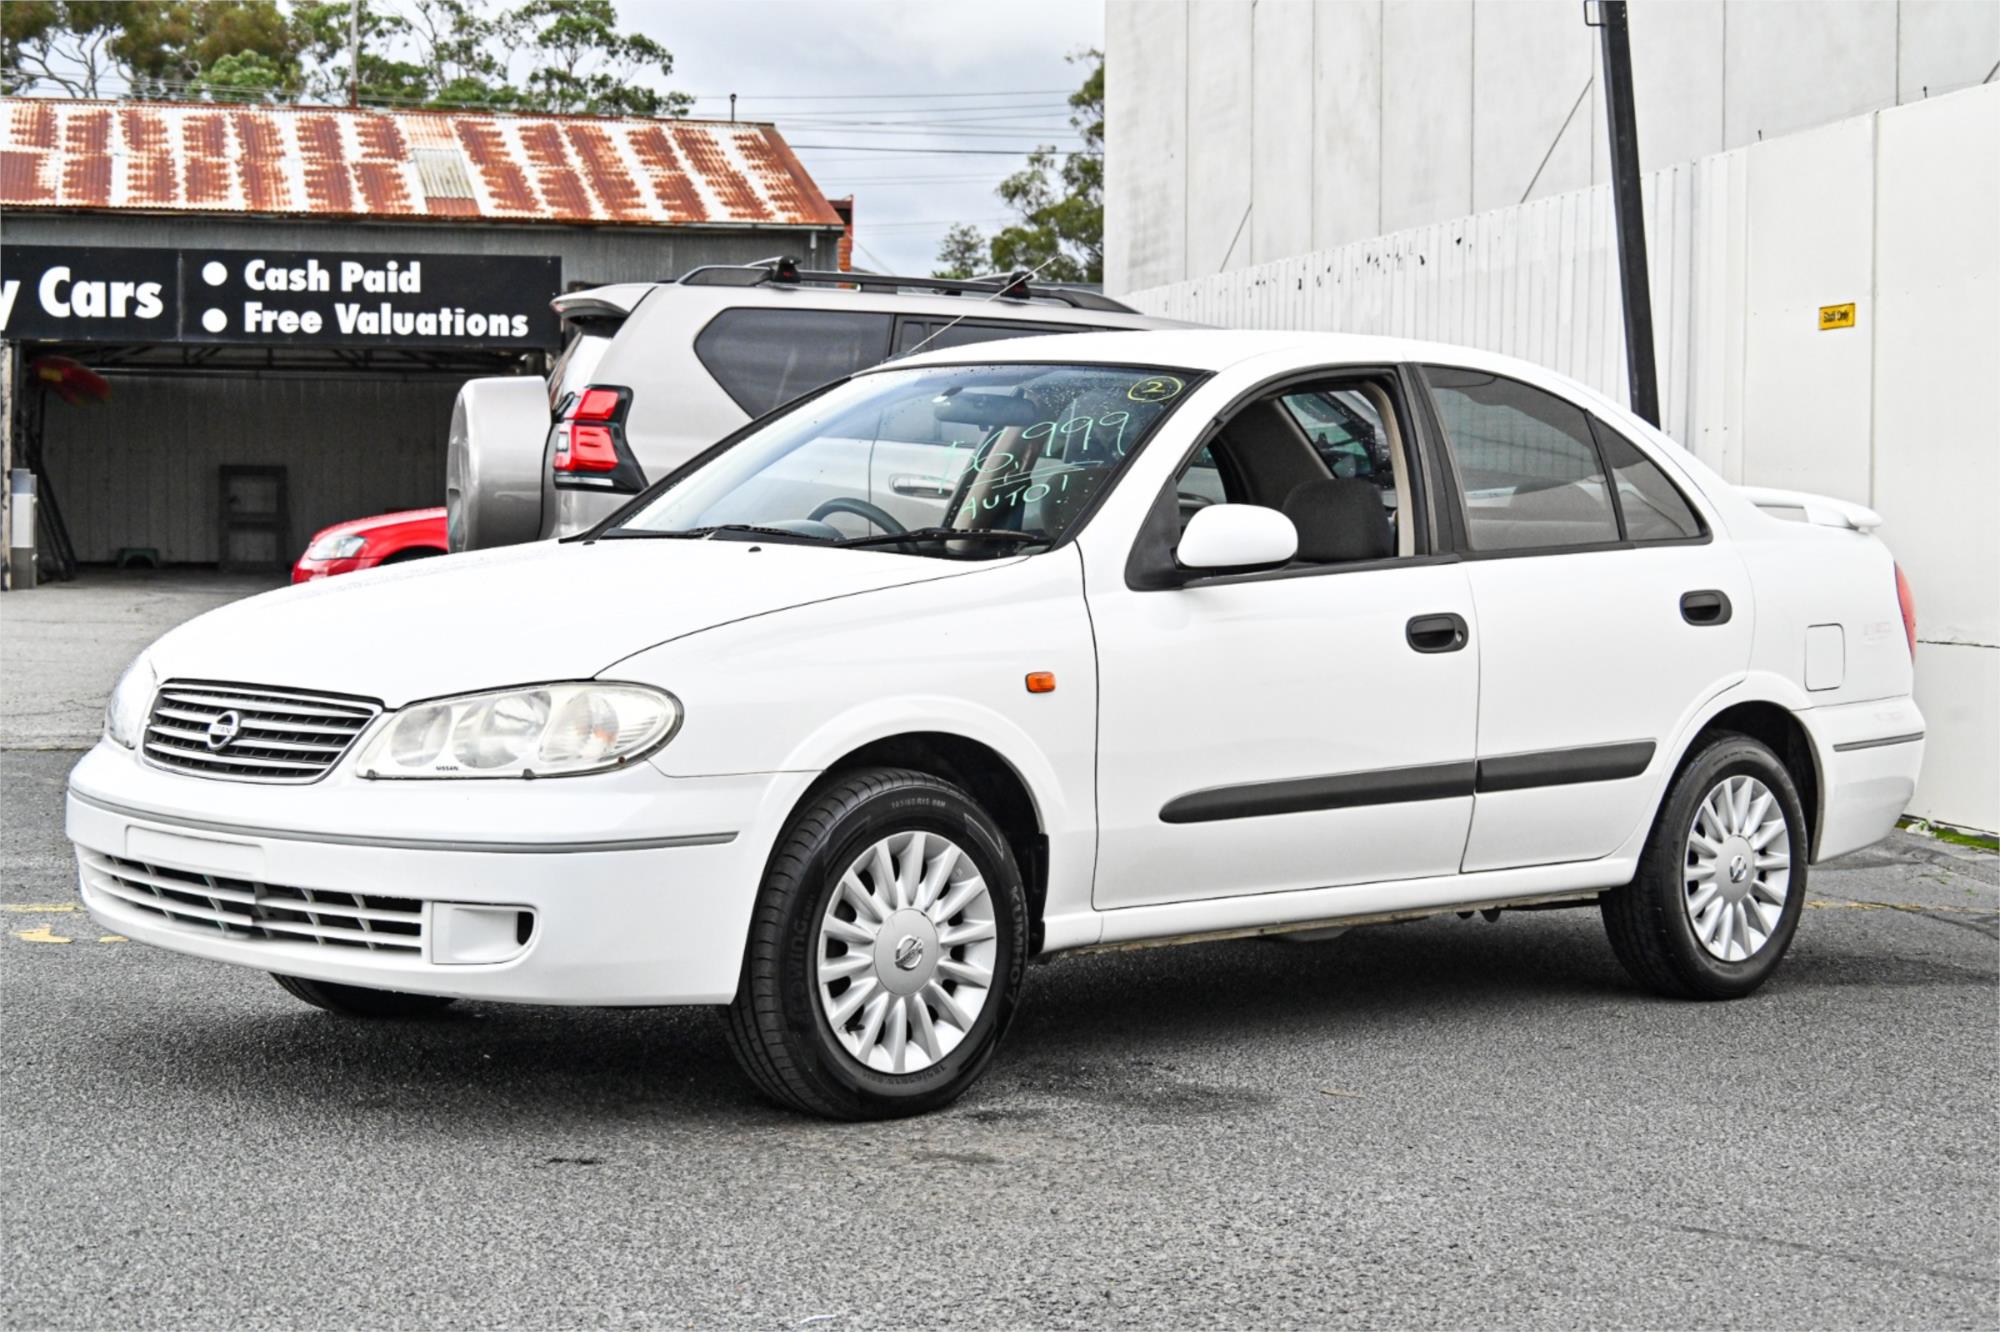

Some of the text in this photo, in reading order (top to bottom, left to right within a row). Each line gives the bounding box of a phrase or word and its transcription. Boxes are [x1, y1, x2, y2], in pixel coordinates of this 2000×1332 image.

[38, 266, 164, 318] Cars
[244, 259, 421, 293] Cash Paid
[244, 302, 529, 337] Free Valuations
